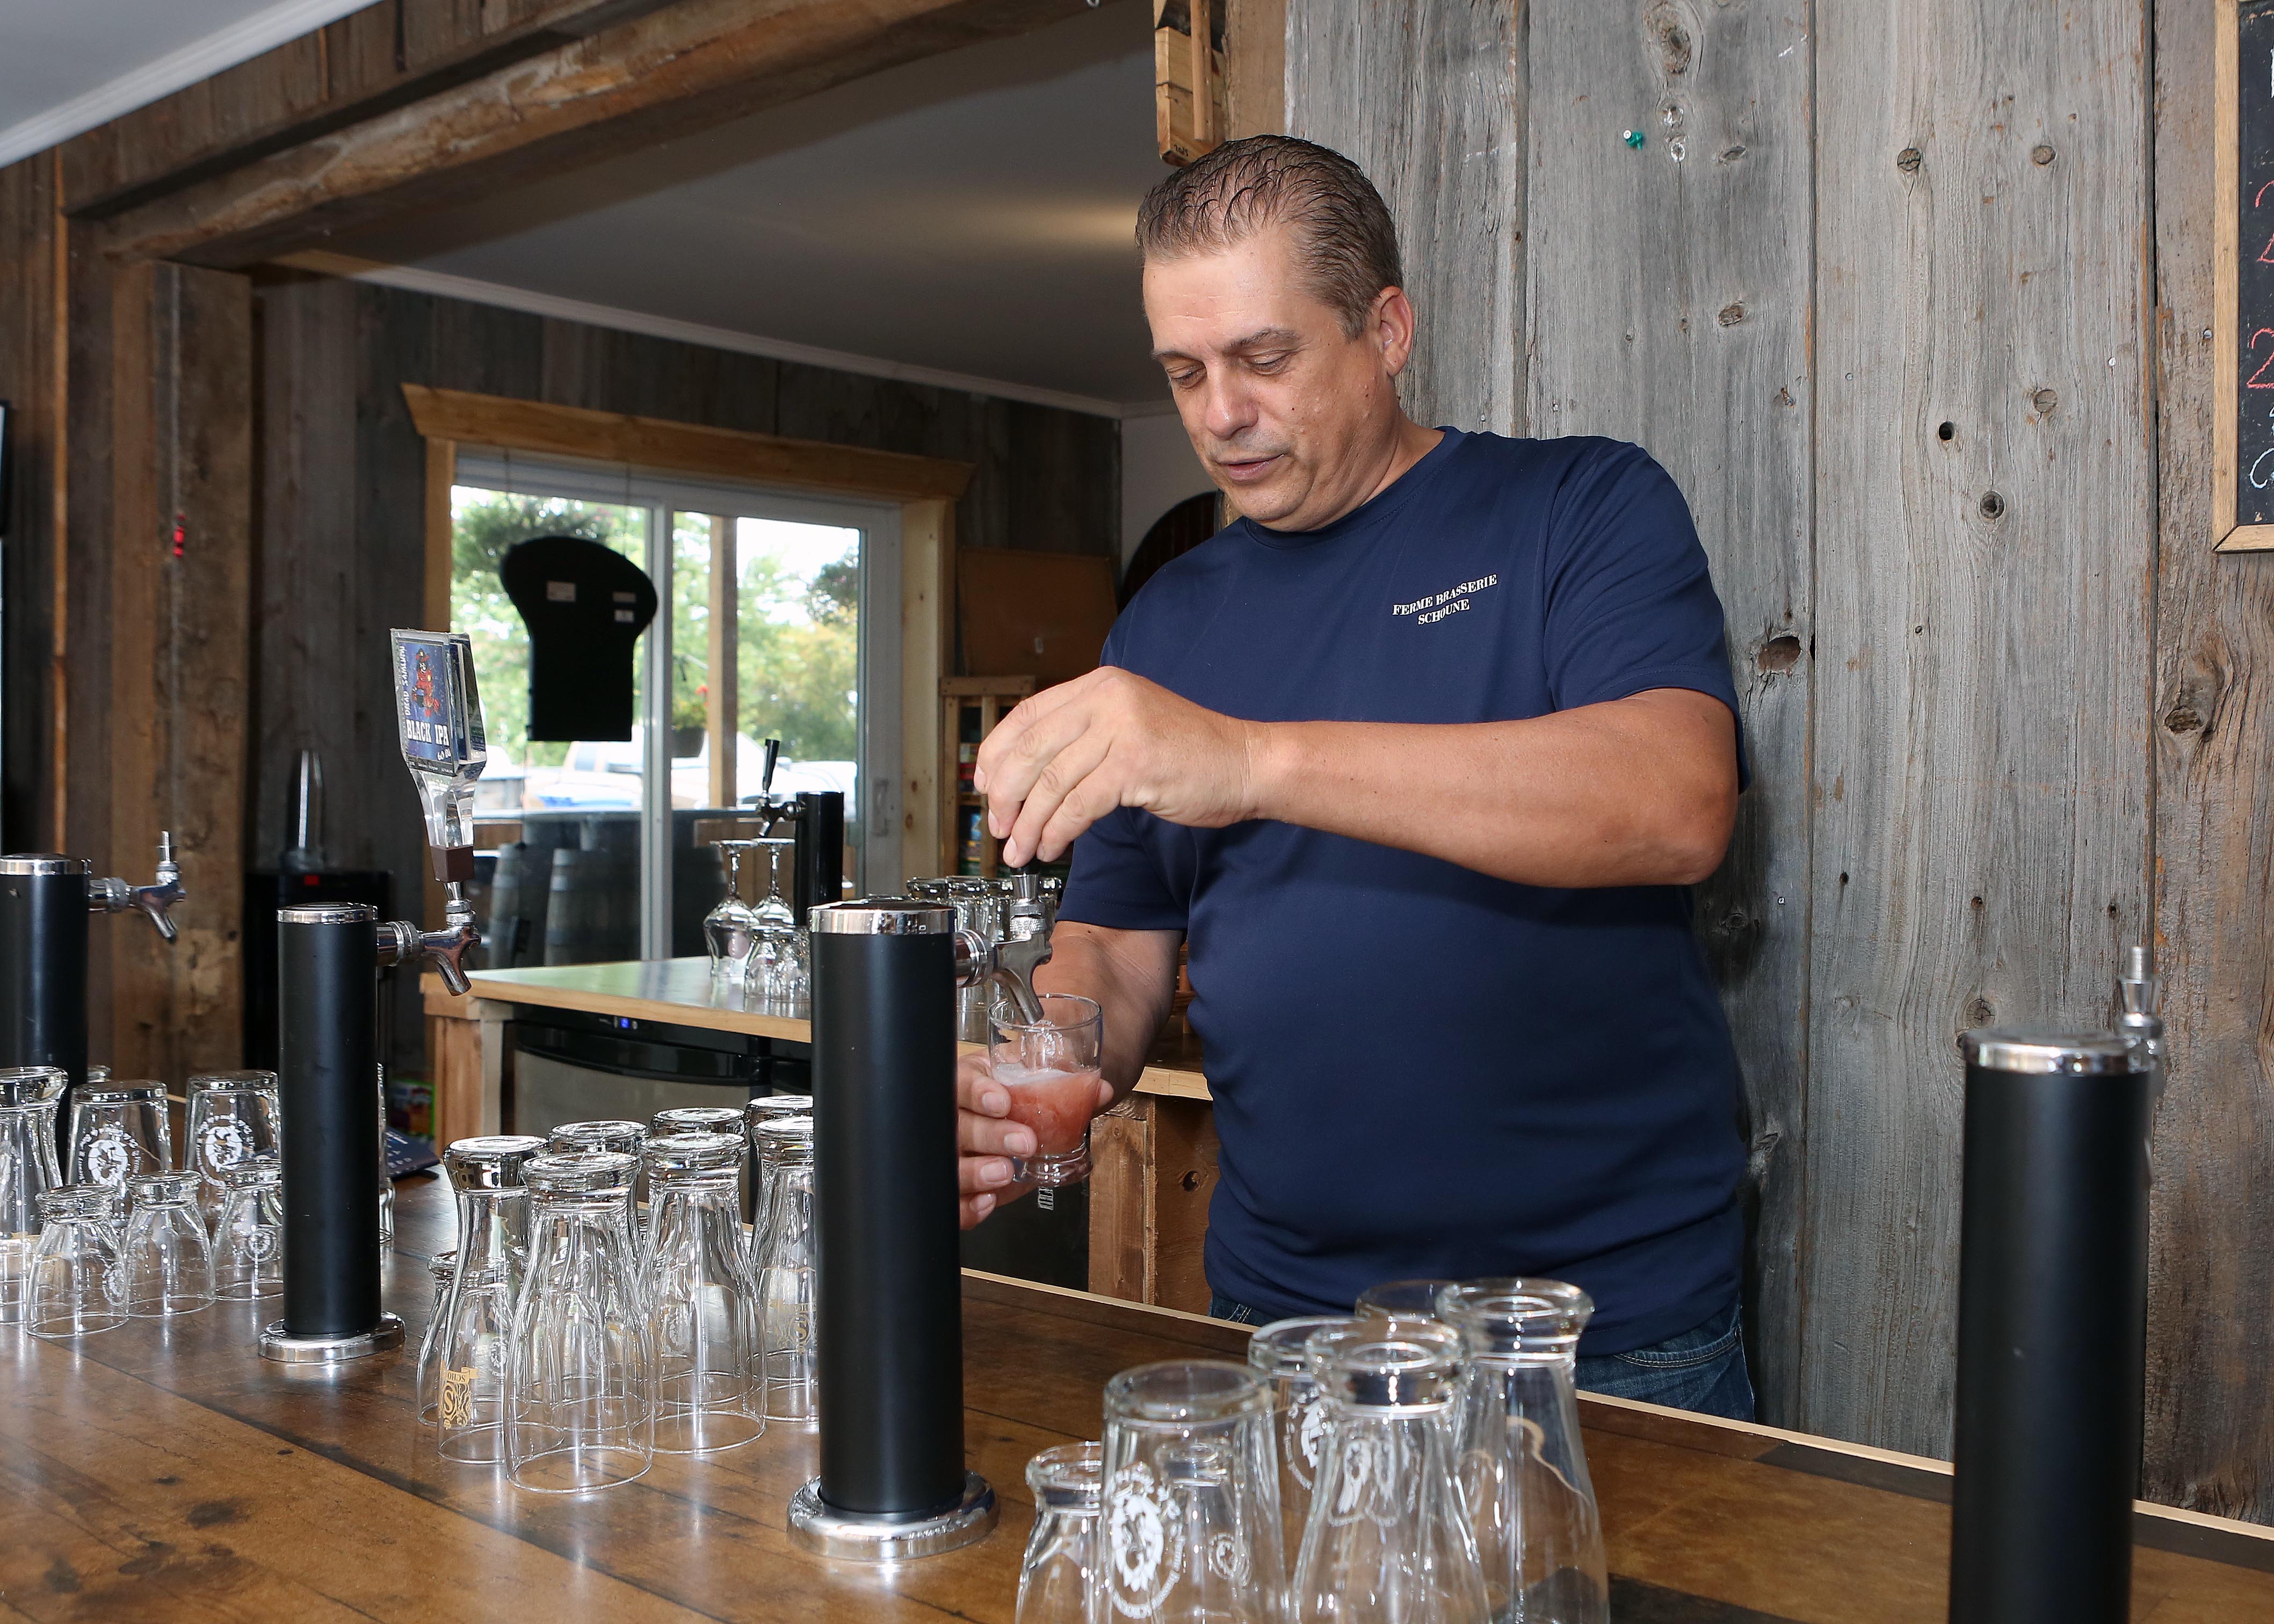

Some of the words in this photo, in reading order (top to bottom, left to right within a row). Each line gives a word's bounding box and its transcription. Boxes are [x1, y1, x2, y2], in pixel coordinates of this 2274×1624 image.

[1392, 597, 1433, 615] FERME
[1436, 574, 1497, 606] BRASSERIE
[1418, 599, 1470, 625] SCHOUNE
[406, 719, 432, 743] BLACK
[434, 724, 450, 746] IPA
[447, 1372, 466, 1382] SCHO
